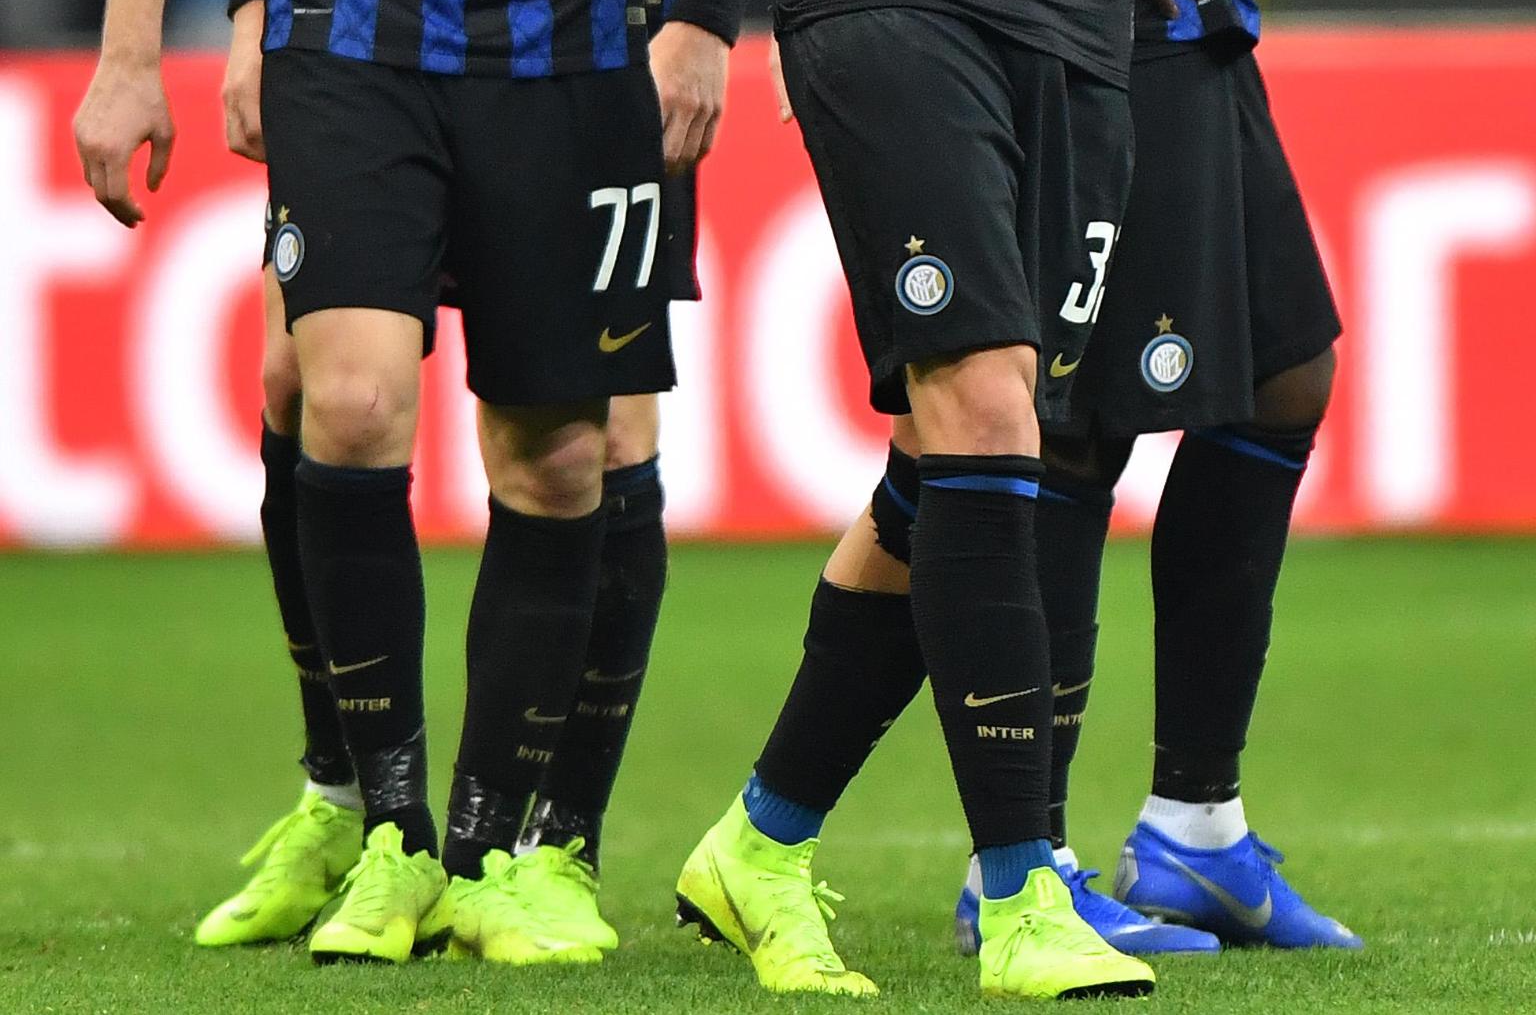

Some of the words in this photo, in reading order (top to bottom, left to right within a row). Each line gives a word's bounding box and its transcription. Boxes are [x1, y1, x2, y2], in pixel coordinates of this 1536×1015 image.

[589, 182, 660, 291] 77
[1059, 221, 1121, 324] 3
[336, 697, 392, 711] INTER
[1053, 713, 1084, 727] INT
[976, 725, 1034, 740] INTER
